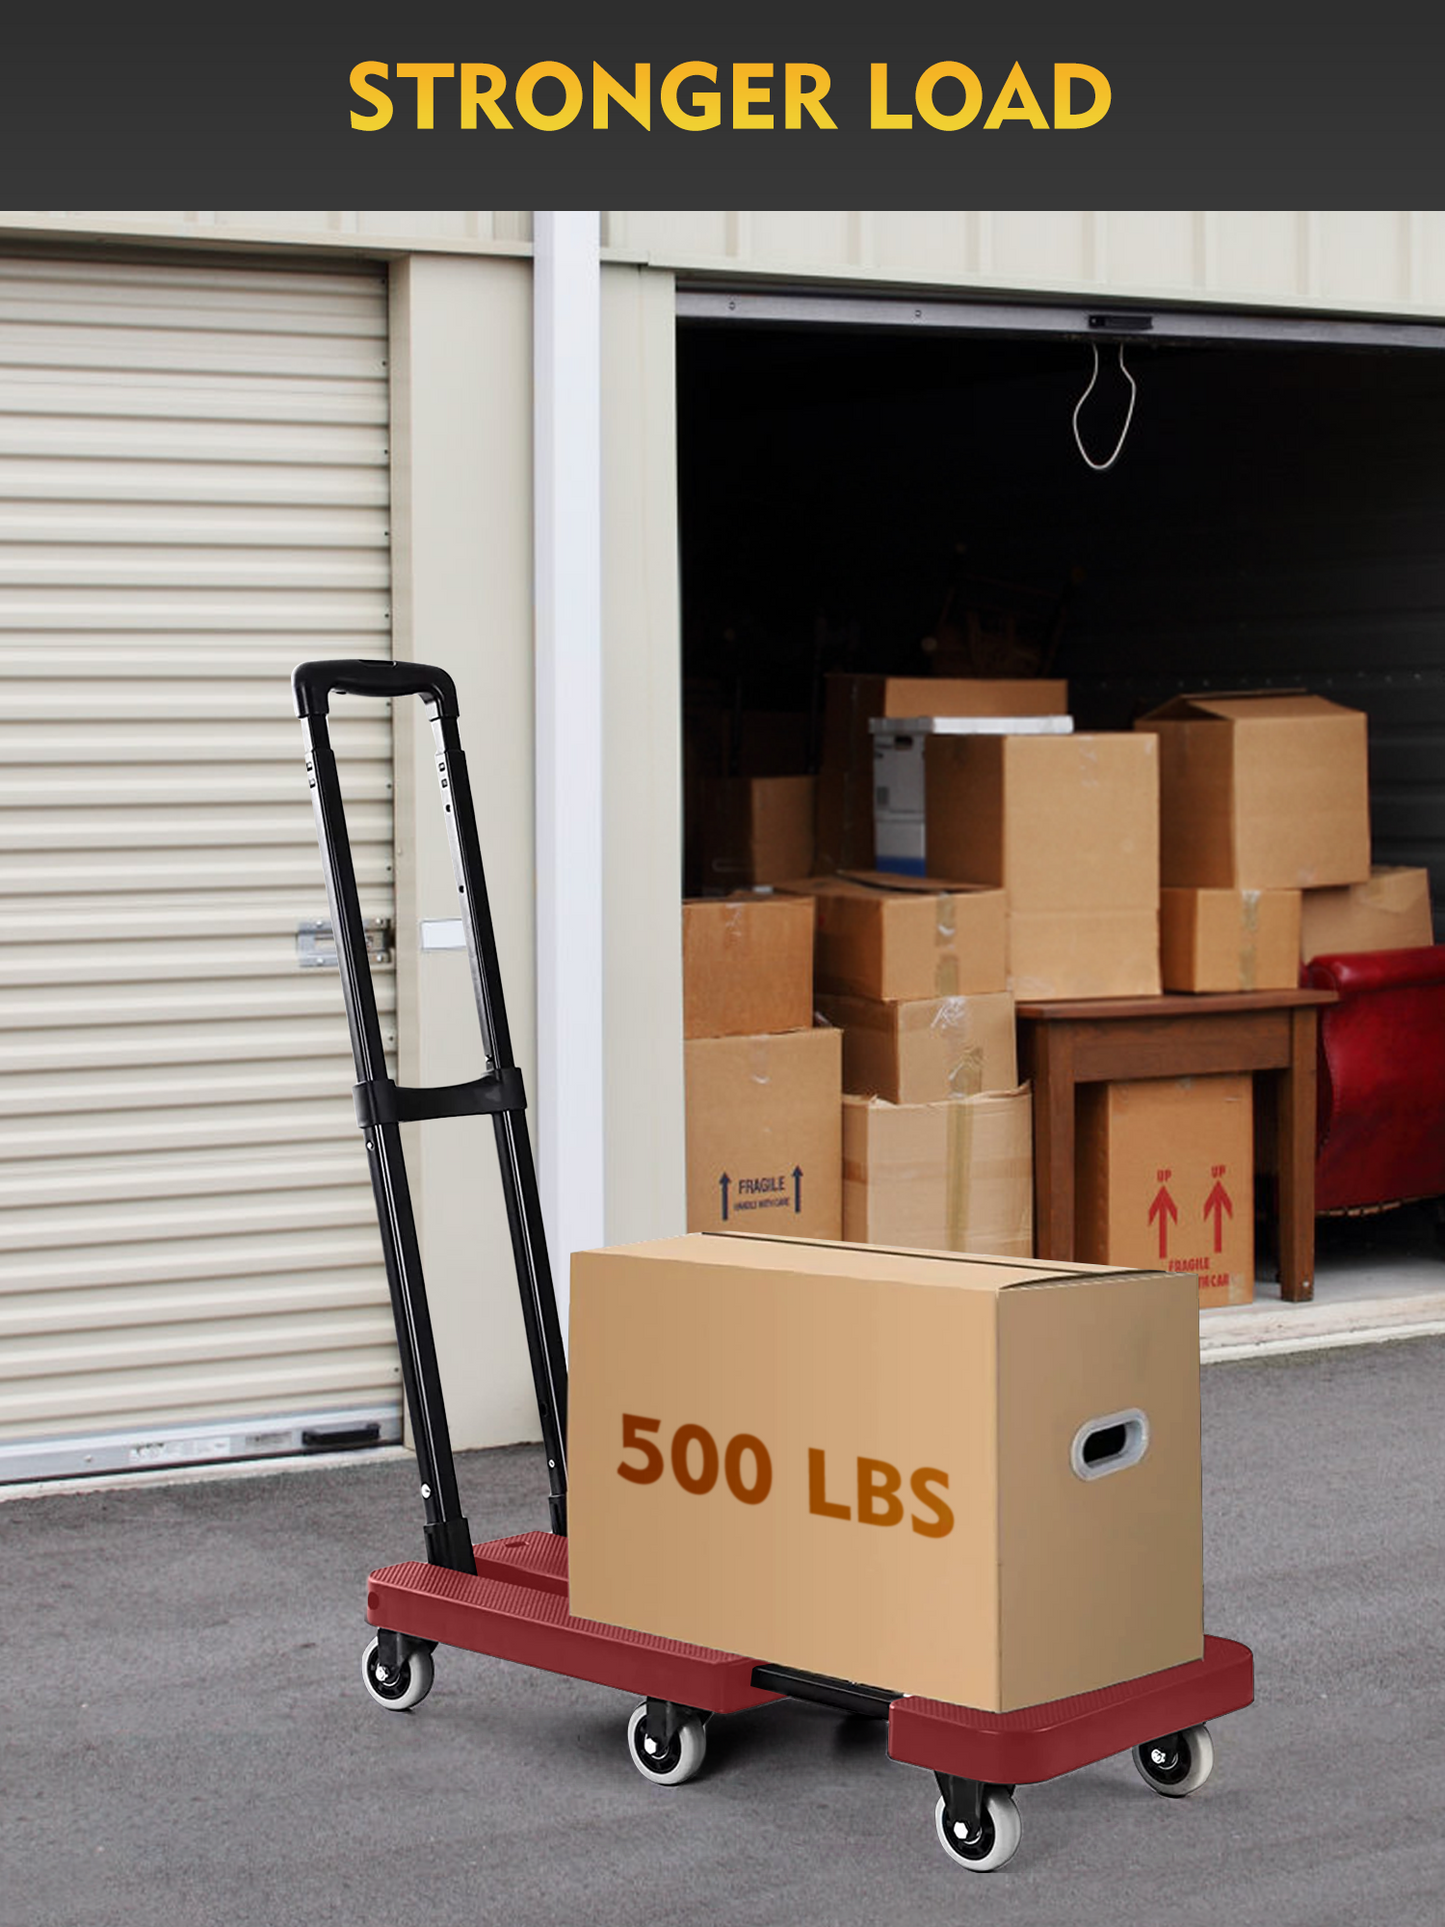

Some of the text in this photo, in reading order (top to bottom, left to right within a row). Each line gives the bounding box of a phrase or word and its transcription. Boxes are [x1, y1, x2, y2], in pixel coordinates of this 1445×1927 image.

[1156, 1164, 1226, 1183] UP UP
[739, 1175, 786, 1195] FRAGILE
[1168, 1256, 1211, 1273] FRAGILE
[1198, 1272, 1230, 1290] TH CAR
[617, 1413, 954, 1538] 500 LBS
